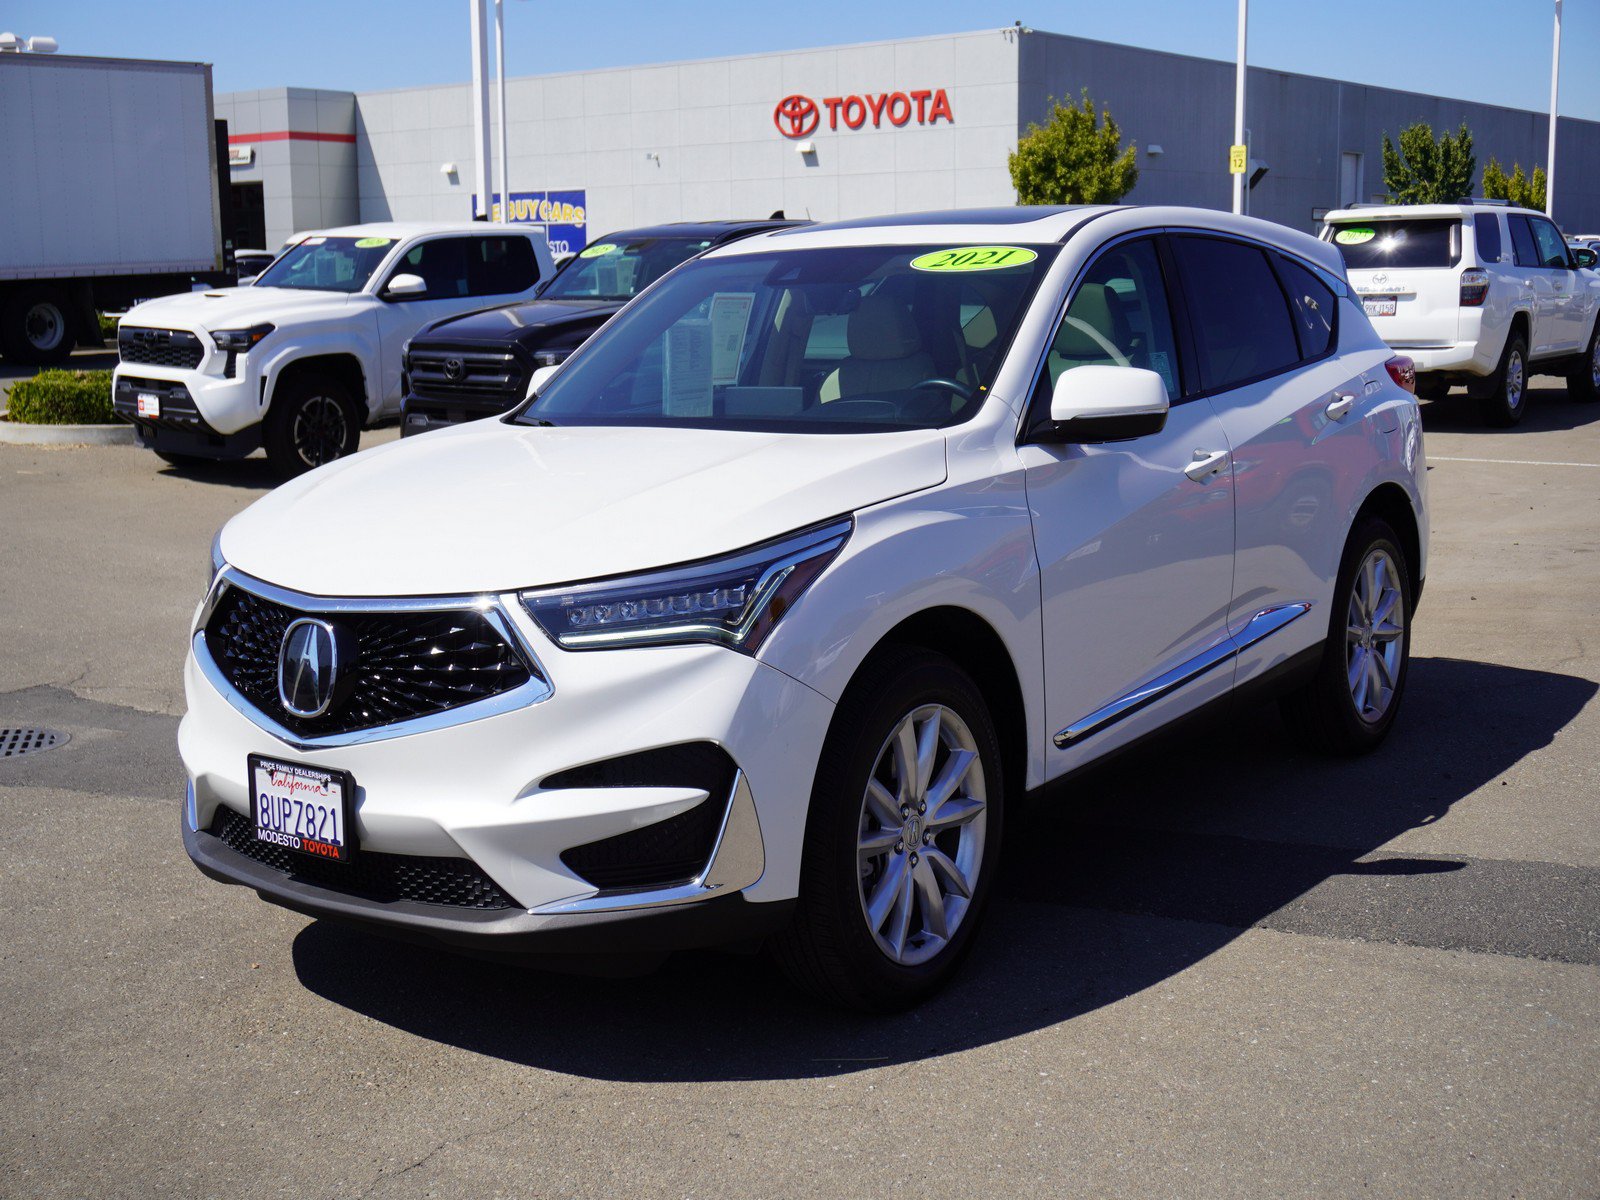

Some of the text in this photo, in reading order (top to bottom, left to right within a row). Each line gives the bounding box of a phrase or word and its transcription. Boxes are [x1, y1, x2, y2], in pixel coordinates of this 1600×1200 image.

[823, 89, 953, 130] TOYOTA
[1233, 159, 1244, 168] 12
[508, 199, 540, 221] BUY
[539, 199, 586, 229] CARS
[928, 250, 1018, 268] 2021
[260, 761, 331, 781] PRICE FAMILY DEALERSHIPS
[270, 770, 328, 796] California
[260, 793, 341, 846] 8UPZ821
[257, 829, 339, 858] MODESTO TOYOTA
